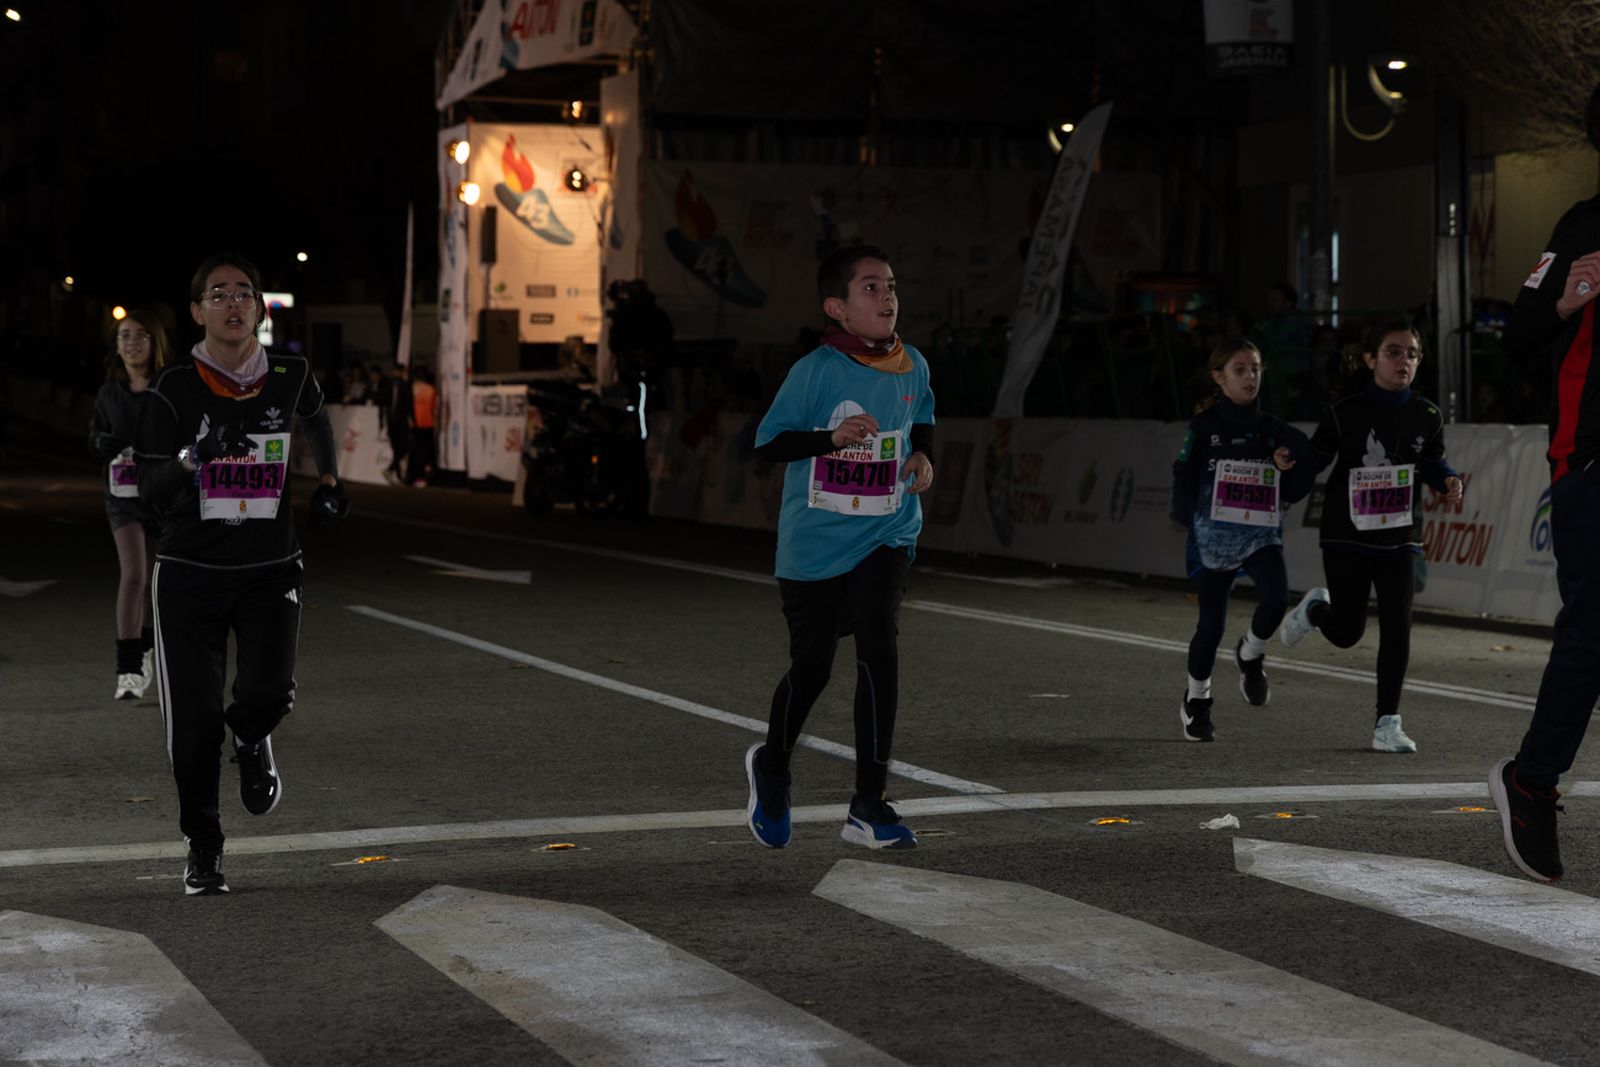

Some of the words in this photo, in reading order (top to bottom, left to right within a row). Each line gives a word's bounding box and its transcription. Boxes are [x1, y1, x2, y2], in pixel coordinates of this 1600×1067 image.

[207, 463, 279, 490] 14493
[825, 461, 891, 488] 15470
[1223, 482, 1272, 506] 15537
[1421, 512, 1493, 567] ANTÓN
